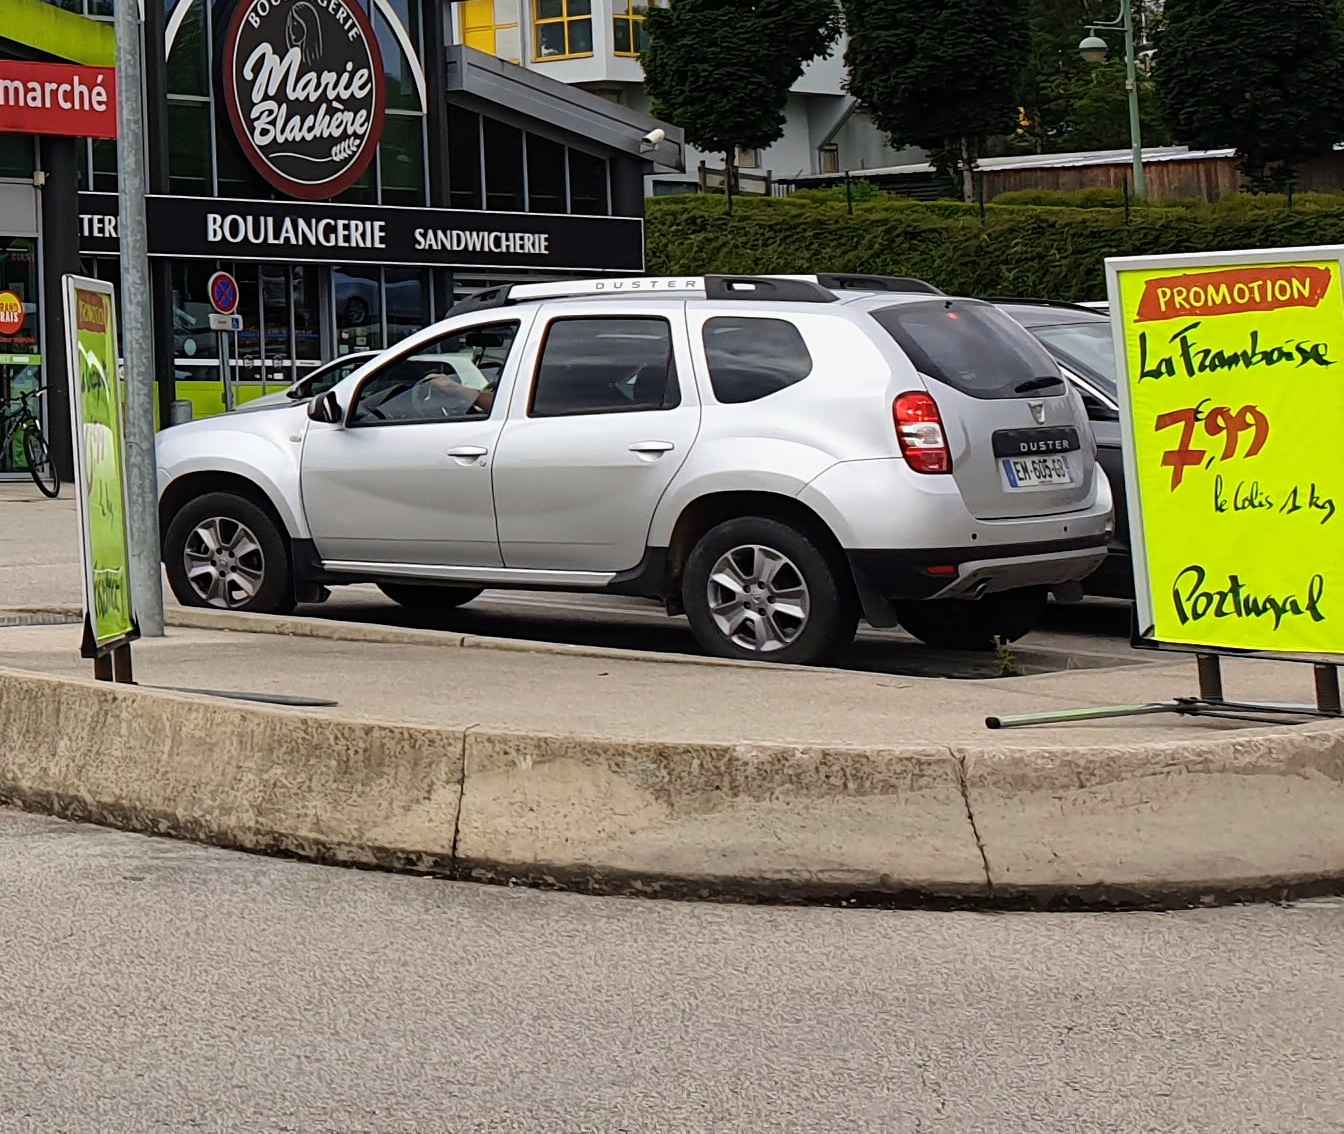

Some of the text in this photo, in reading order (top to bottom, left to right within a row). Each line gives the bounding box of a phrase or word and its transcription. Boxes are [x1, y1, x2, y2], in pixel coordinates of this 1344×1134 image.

[243, 42, 371, 103] Marie
[250, 100, 369, 146] Blachère
[207, 214, 386, 248] BOULANGERIE
[415, 229, 549, 254] SANDWICHERIE
[595, 280, 696, 290] DUSTER
[1157, 277, 1310, 312] PROMOTION
[1138, 321, 1337, 383] La Framboise
[1020, 440, 1070, 452] DUSTER
[1215, 474, 1228, 512] le
[1172, 564, 1326, 632] Portugal
